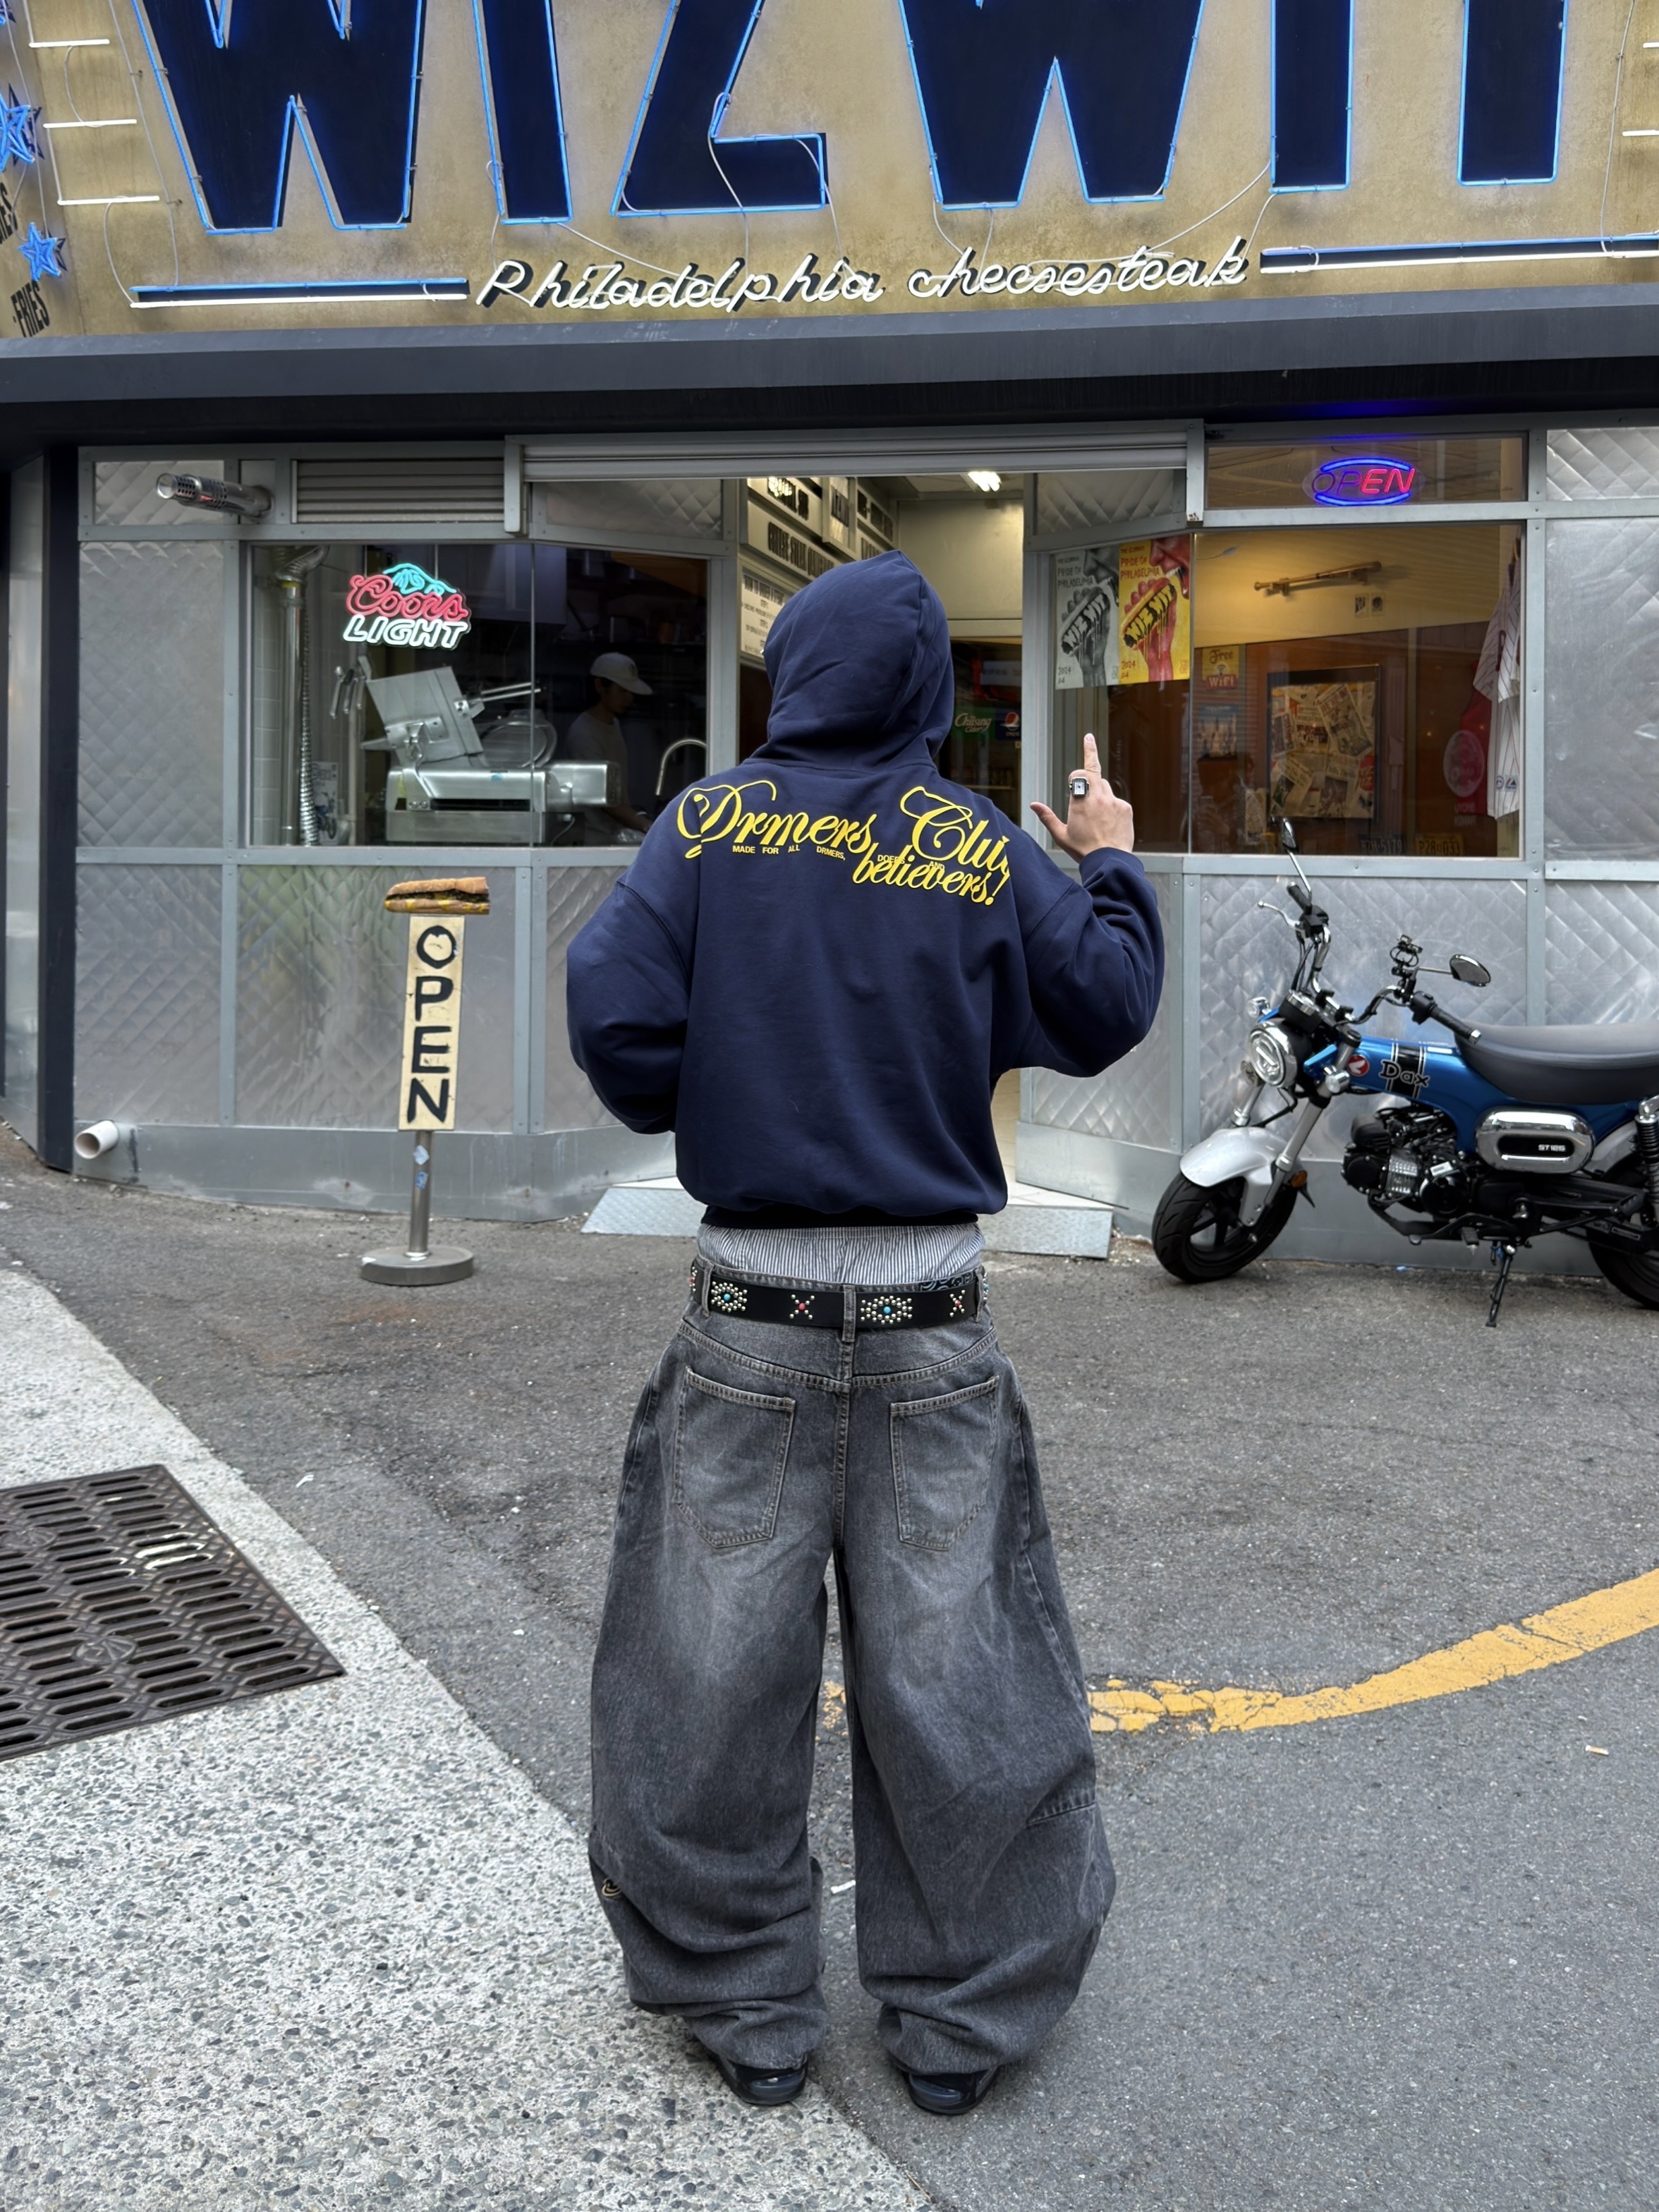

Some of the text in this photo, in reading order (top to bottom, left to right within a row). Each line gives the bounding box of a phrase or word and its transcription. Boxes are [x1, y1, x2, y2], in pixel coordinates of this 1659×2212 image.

[476, 253, 885, 312] Philadelphia
[11, 280, 50, 338] FRIES
[1312, 468, 1415, 494] OPEN
[1121, 557, 1138, 567] PRIDE
[1121, 567, 1160, 580] PHILADELPHIA
[1058, 578, 1093, 588] PHILADELPHIA
[346, 574, 469, 621] Coors
[343, 614, 469, 648] LIGHT
[1122, 660, 1136, 669] 2024
[1209, 649, 1234, 664] Free
[732, 845, 755, 853] MADE
[788, 844, 801, 853] ALL
[816, 846, 846, 861] DRMERS,
[929, 861, 945, 871] AND
[407, 925, 457, 1124] OPEN
[1378, 1058, 1430, 1088] Dax
